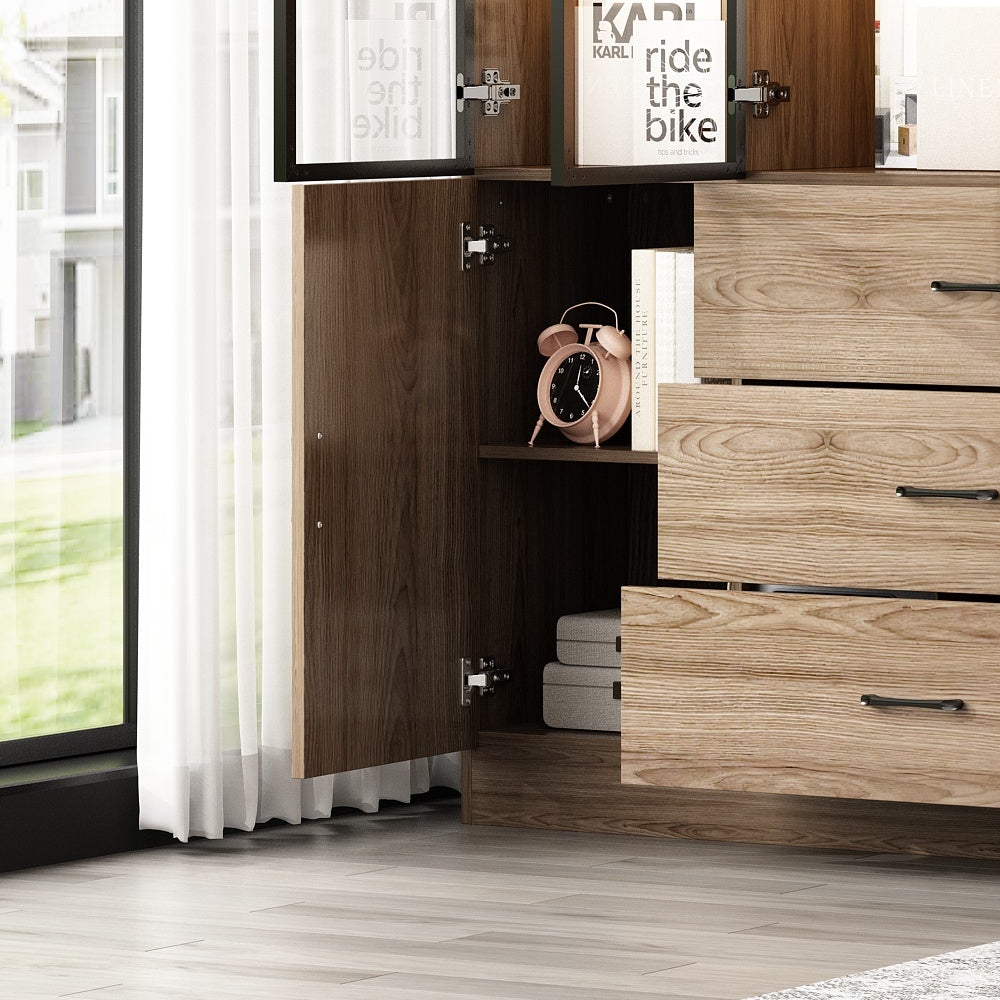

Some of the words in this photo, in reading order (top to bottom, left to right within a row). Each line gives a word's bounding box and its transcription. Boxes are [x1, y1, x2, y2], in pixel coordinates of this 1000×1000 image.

[592, 46, 629, 59] KARL
[646, 40, 712, 73] ride
[646, 74, 702, 108] the
[646, 109, 717, 143] bike
